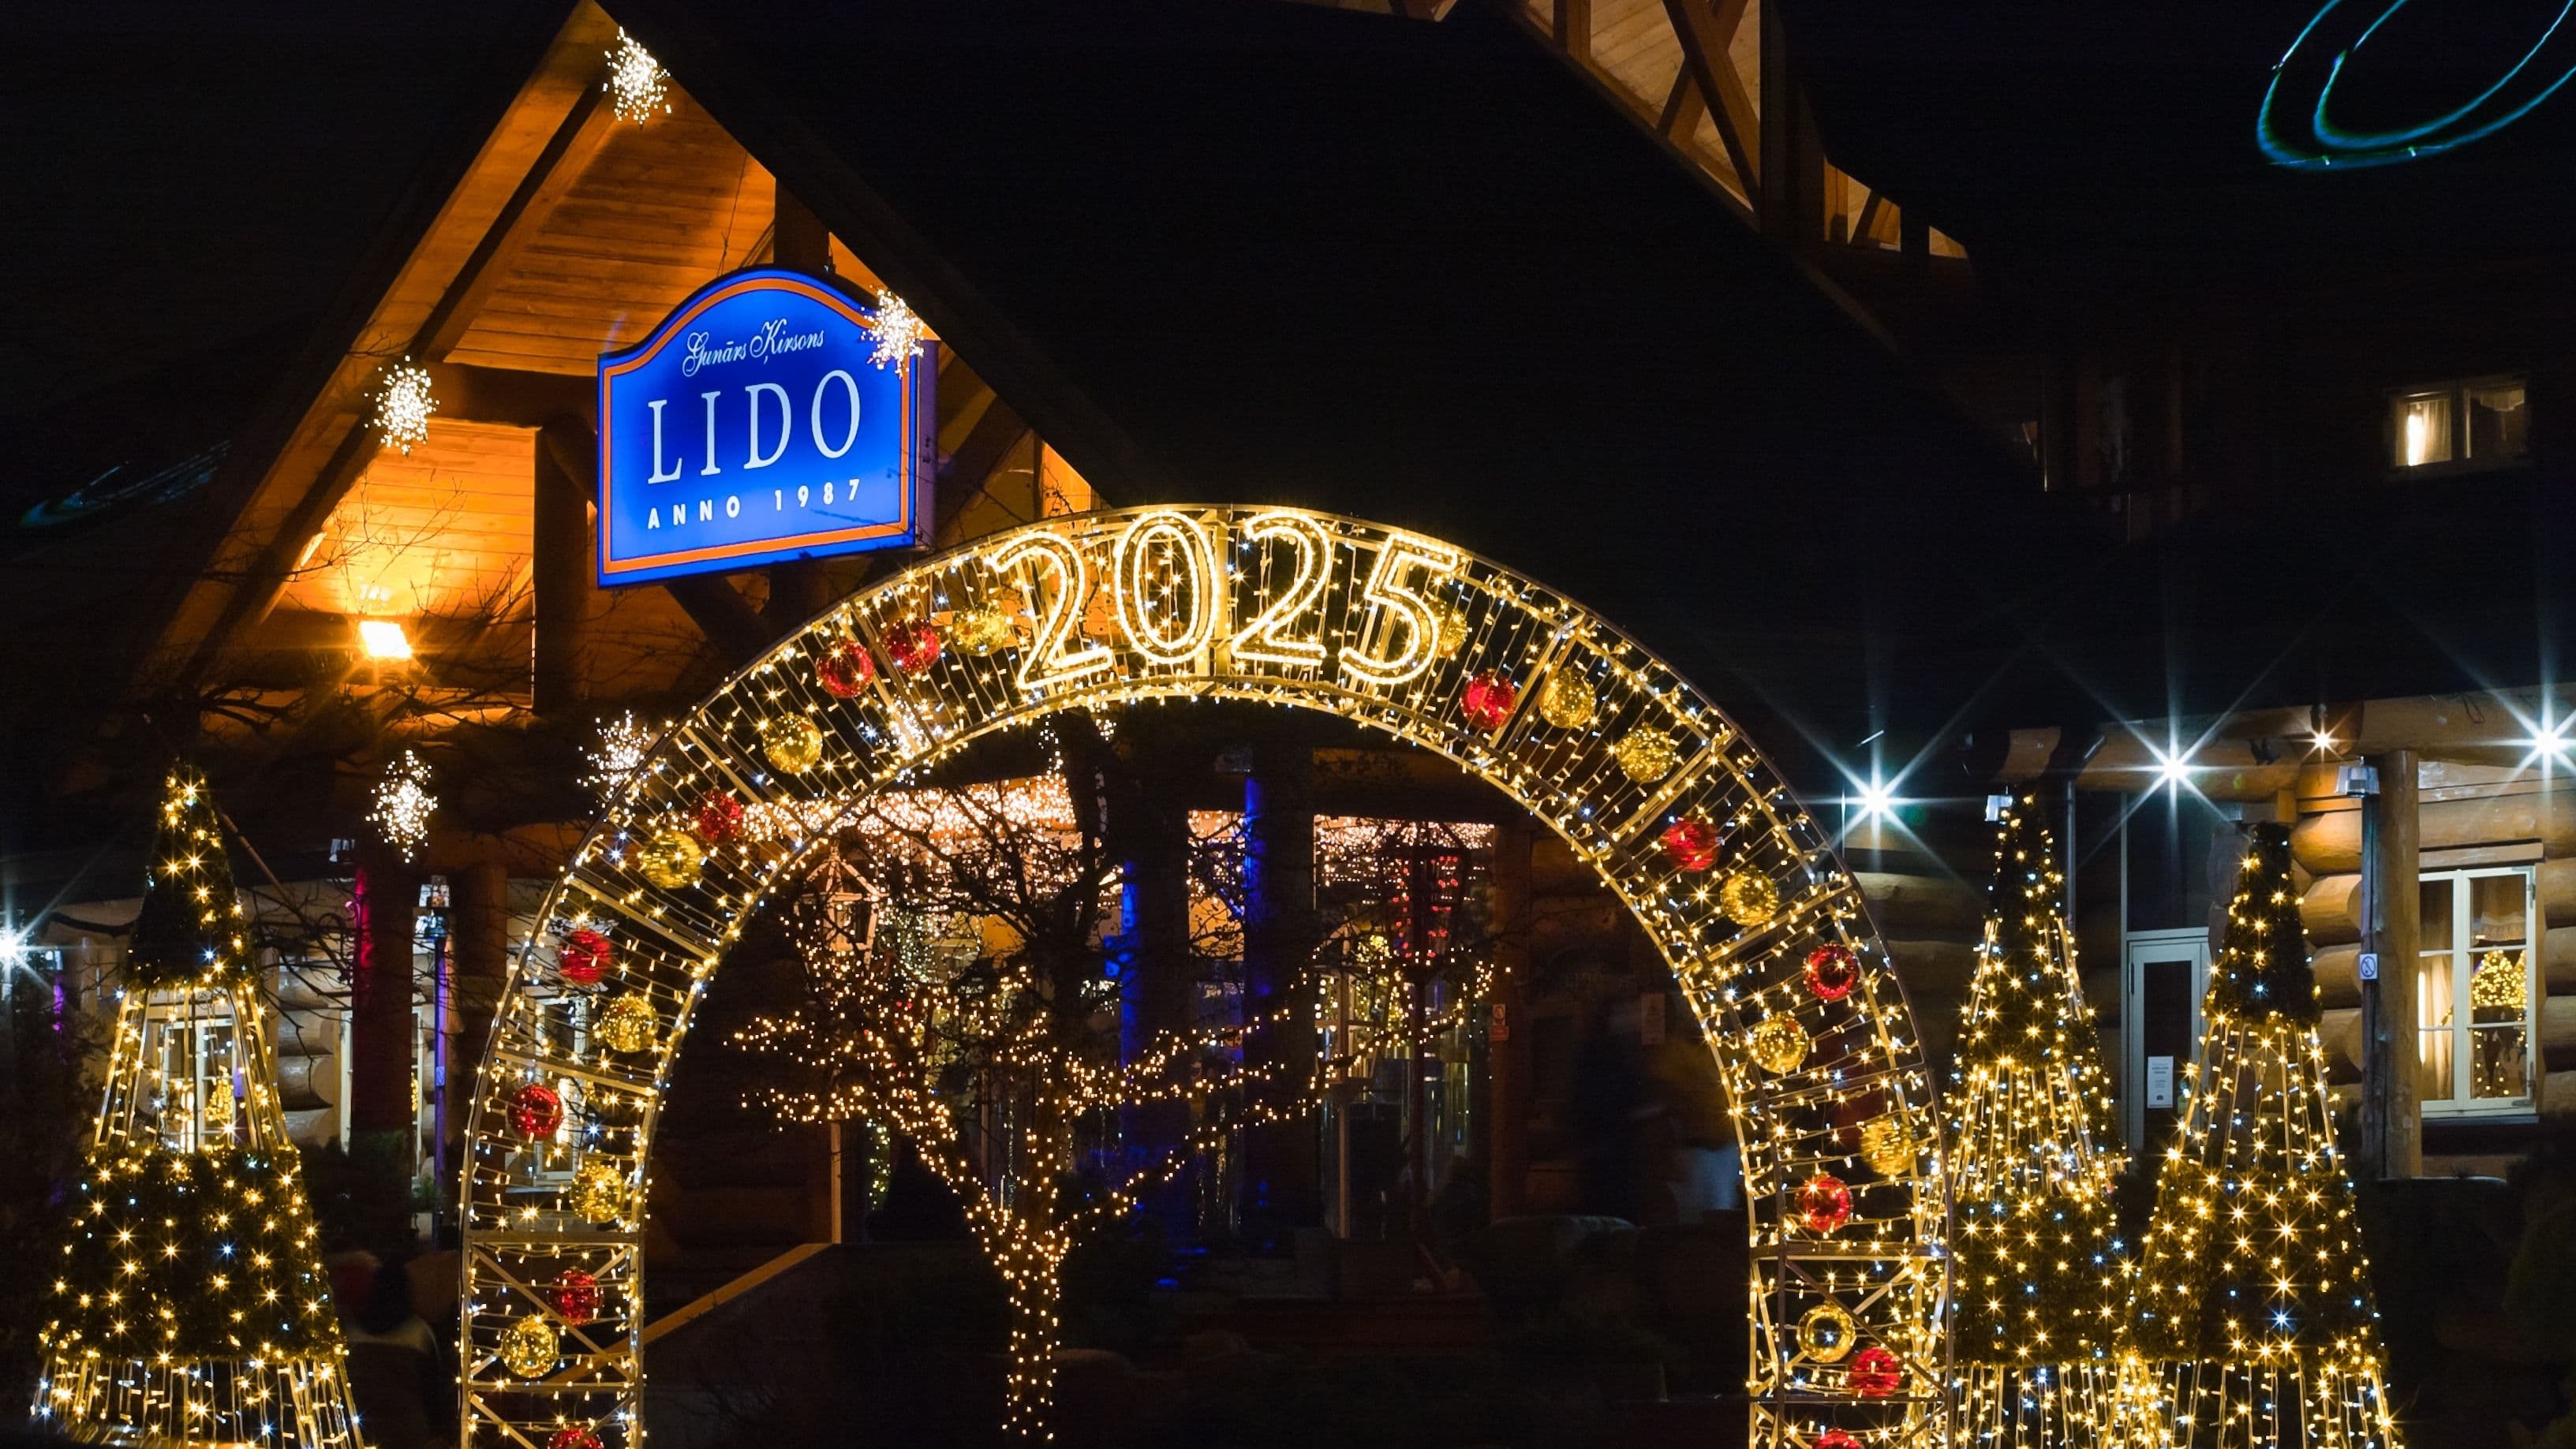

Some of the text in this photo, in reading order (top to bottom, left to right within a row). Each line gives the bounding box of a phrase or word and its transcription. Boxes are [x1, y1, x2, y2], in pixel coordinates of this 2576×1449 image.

[682, 318, 824, 377] Gunārs Ķirsons
[647, 369, 861, 485] LIDO
[647, 478, 860, 530] ANNO 1987
[985, 510, 1458, 689] 2025
